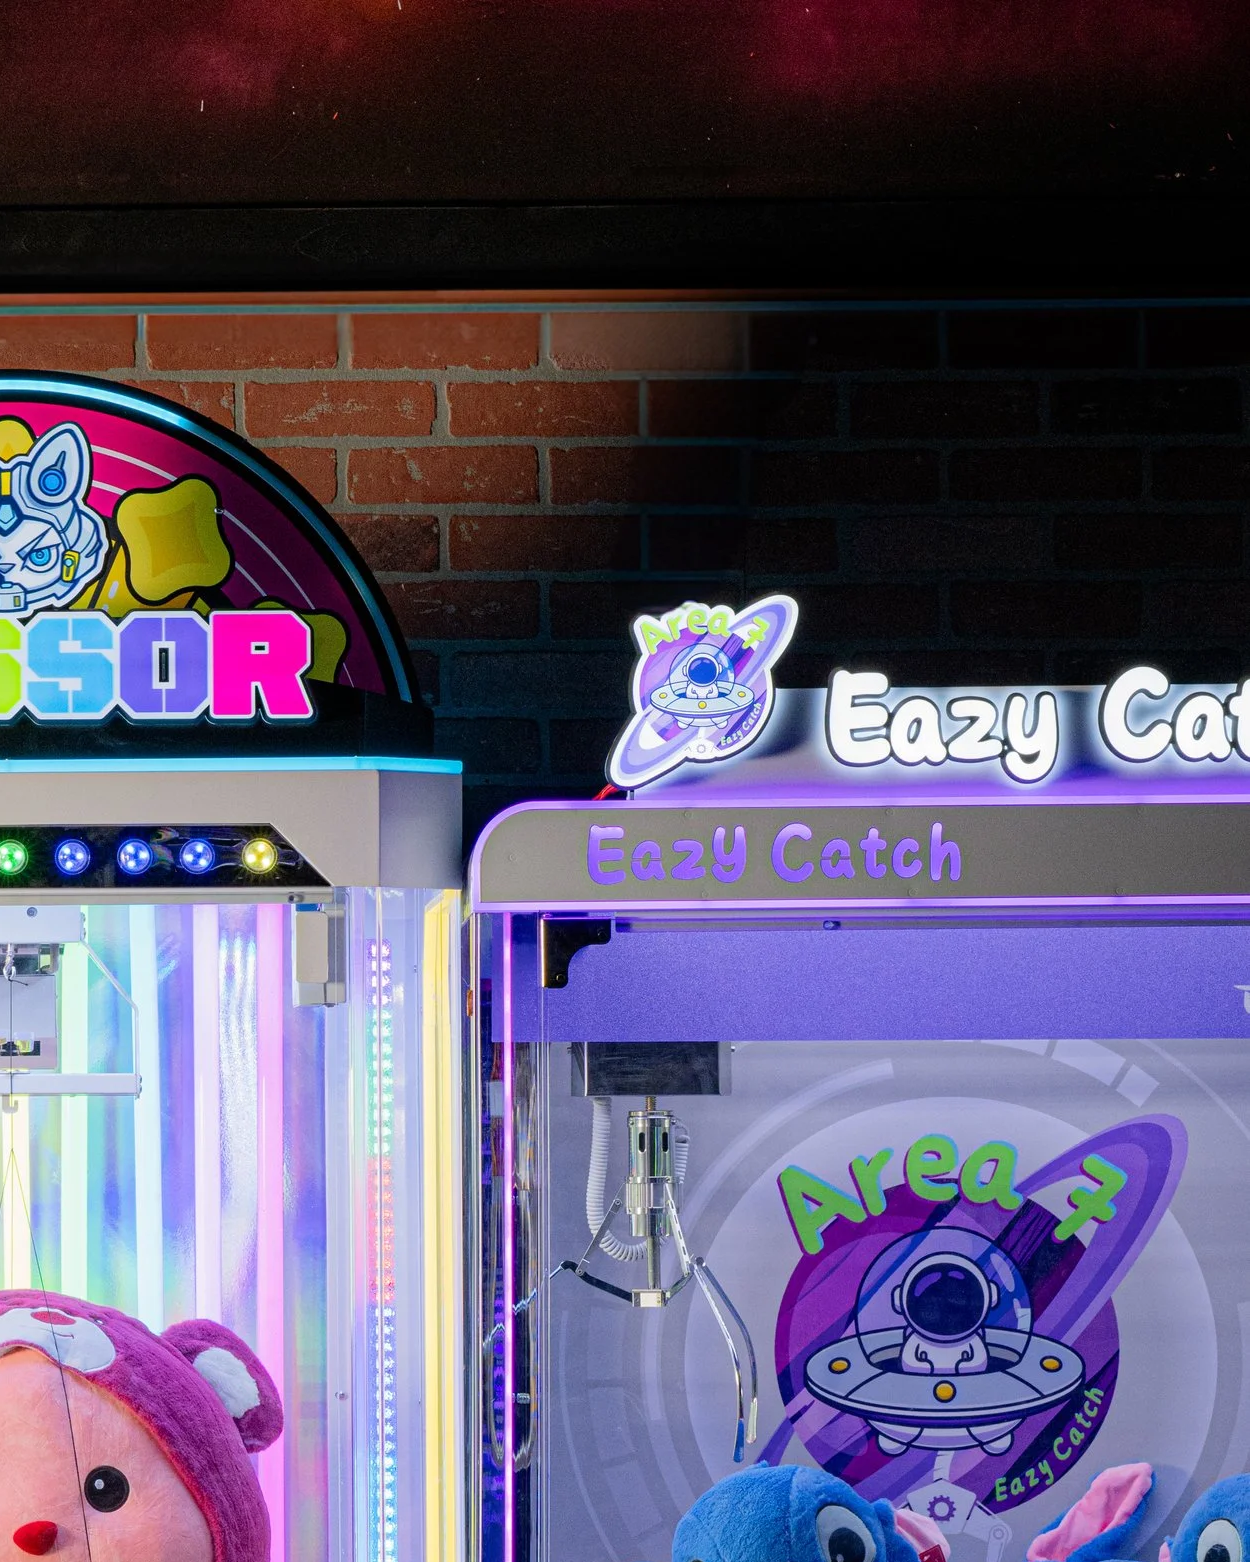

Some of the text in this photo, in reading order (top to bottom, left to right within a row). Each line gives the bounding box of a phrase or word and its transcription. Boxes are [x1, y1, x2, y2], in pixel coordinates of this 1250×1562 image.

[639, 610, 735, 655] Area
[719, 702, 763, 747] Eazy Catch
[827, 668, 1058, 784] Eazy
[587, 822, 962, 886] Eazy Catch
[778, 1133, 1130, 1256] Area 7
[993, 1385, 1105, 1503] Eazy Catch
